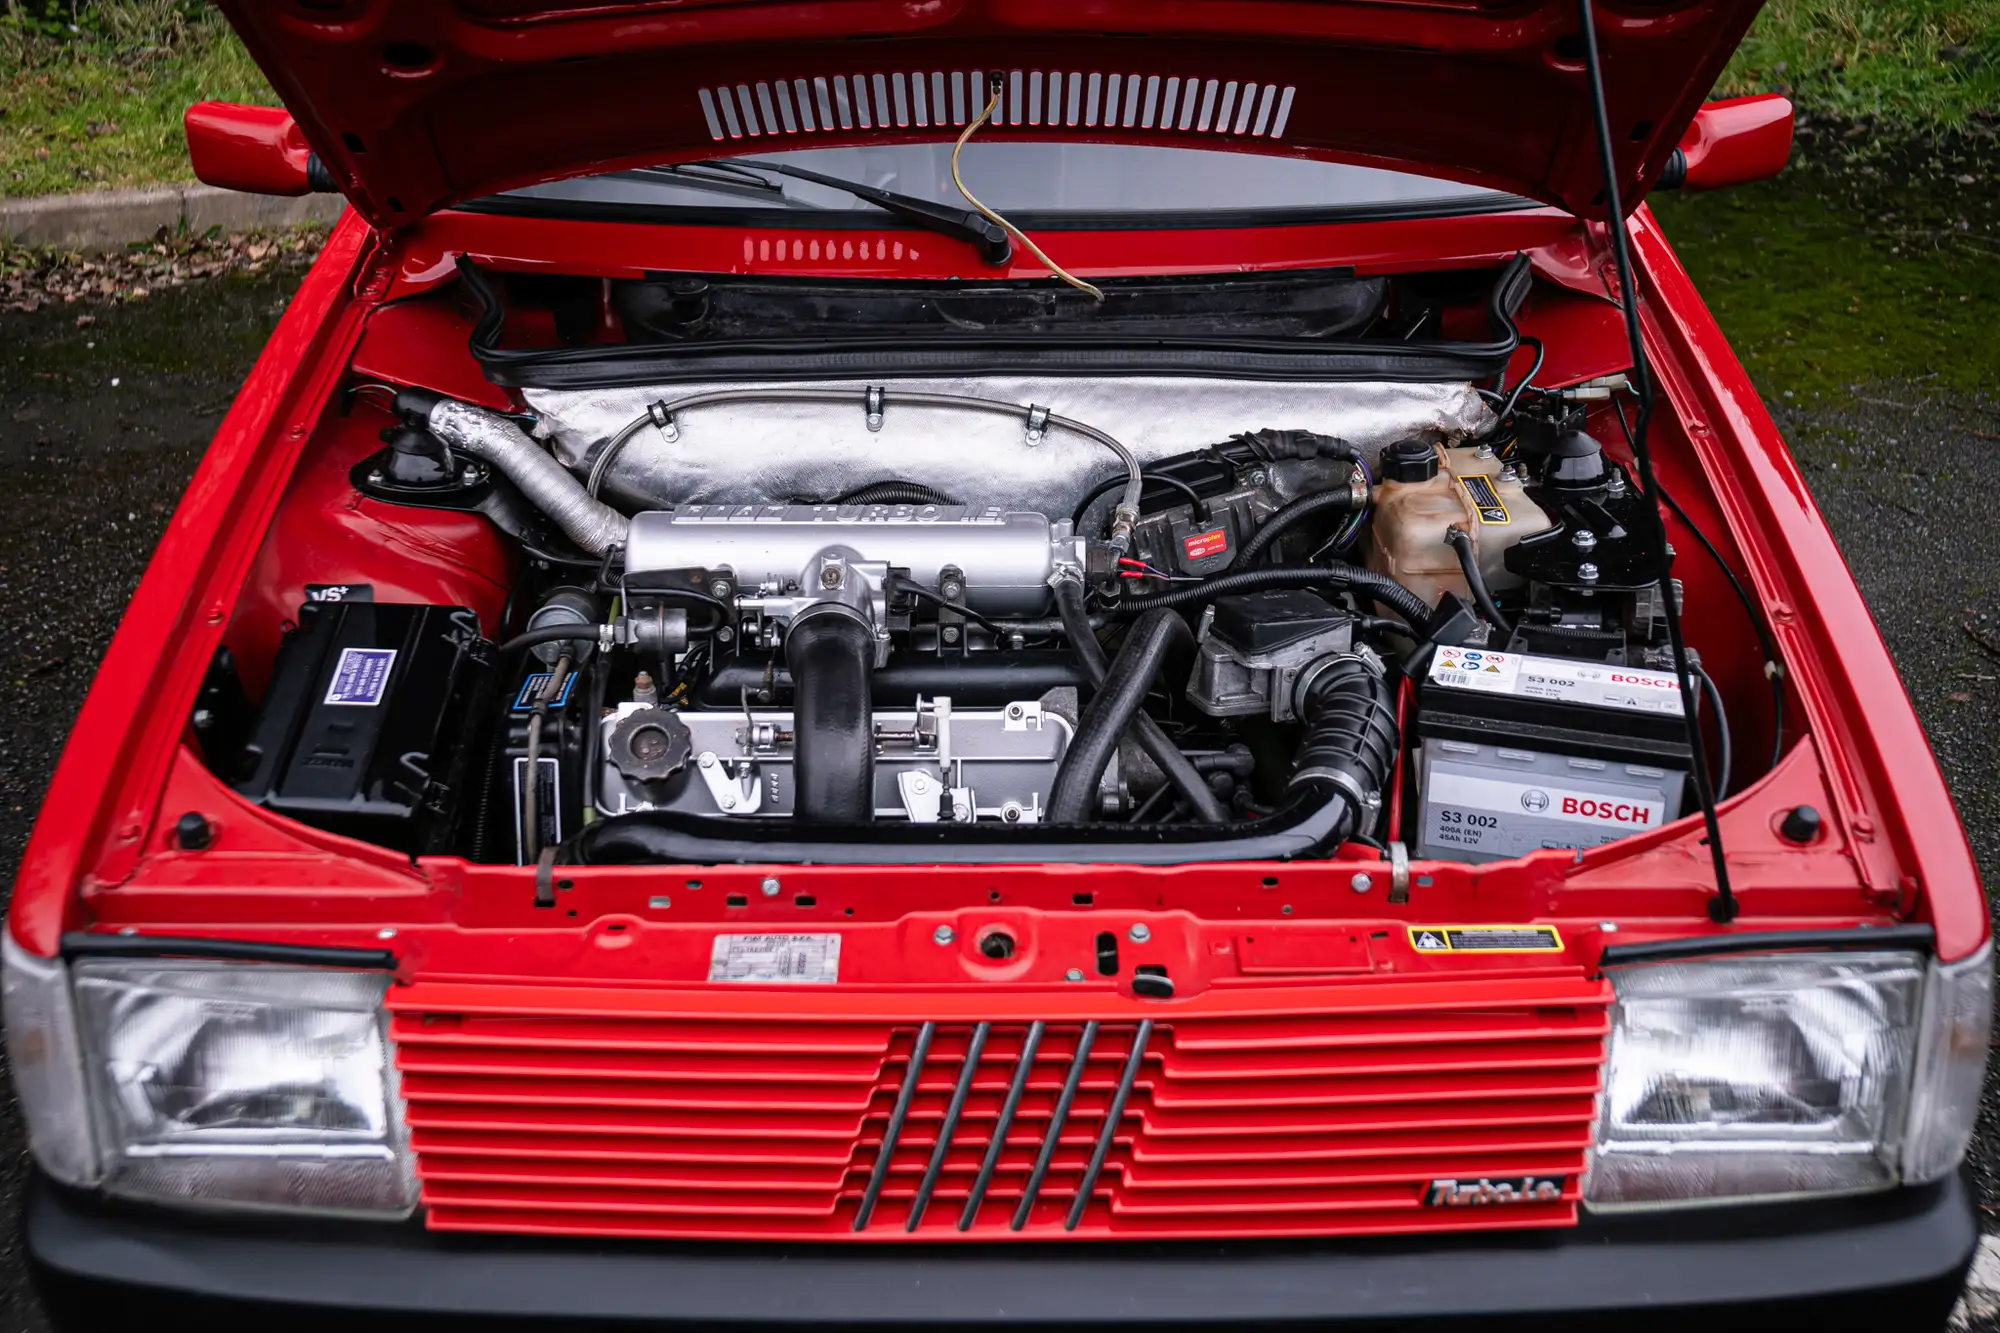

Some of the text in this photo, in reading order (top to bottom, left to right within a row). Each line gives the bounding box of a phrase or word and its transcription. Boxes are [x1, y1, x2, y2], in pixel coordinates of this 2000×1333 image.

[675, 504, 790, 522] FIAT
[811, 504, 943, 522] TURBO
[1528, 676, 1575, 687] S3 002
[1611, 674, 1680, 690] BOSCH
[1562, 797, 1649, 824] BOSCH
[1441, 810, 1497, 828] S3 002
[1439, 833, 1479, 844] 45Ah 12V
[1440, 825, 1482, 837] 400A (EN)
